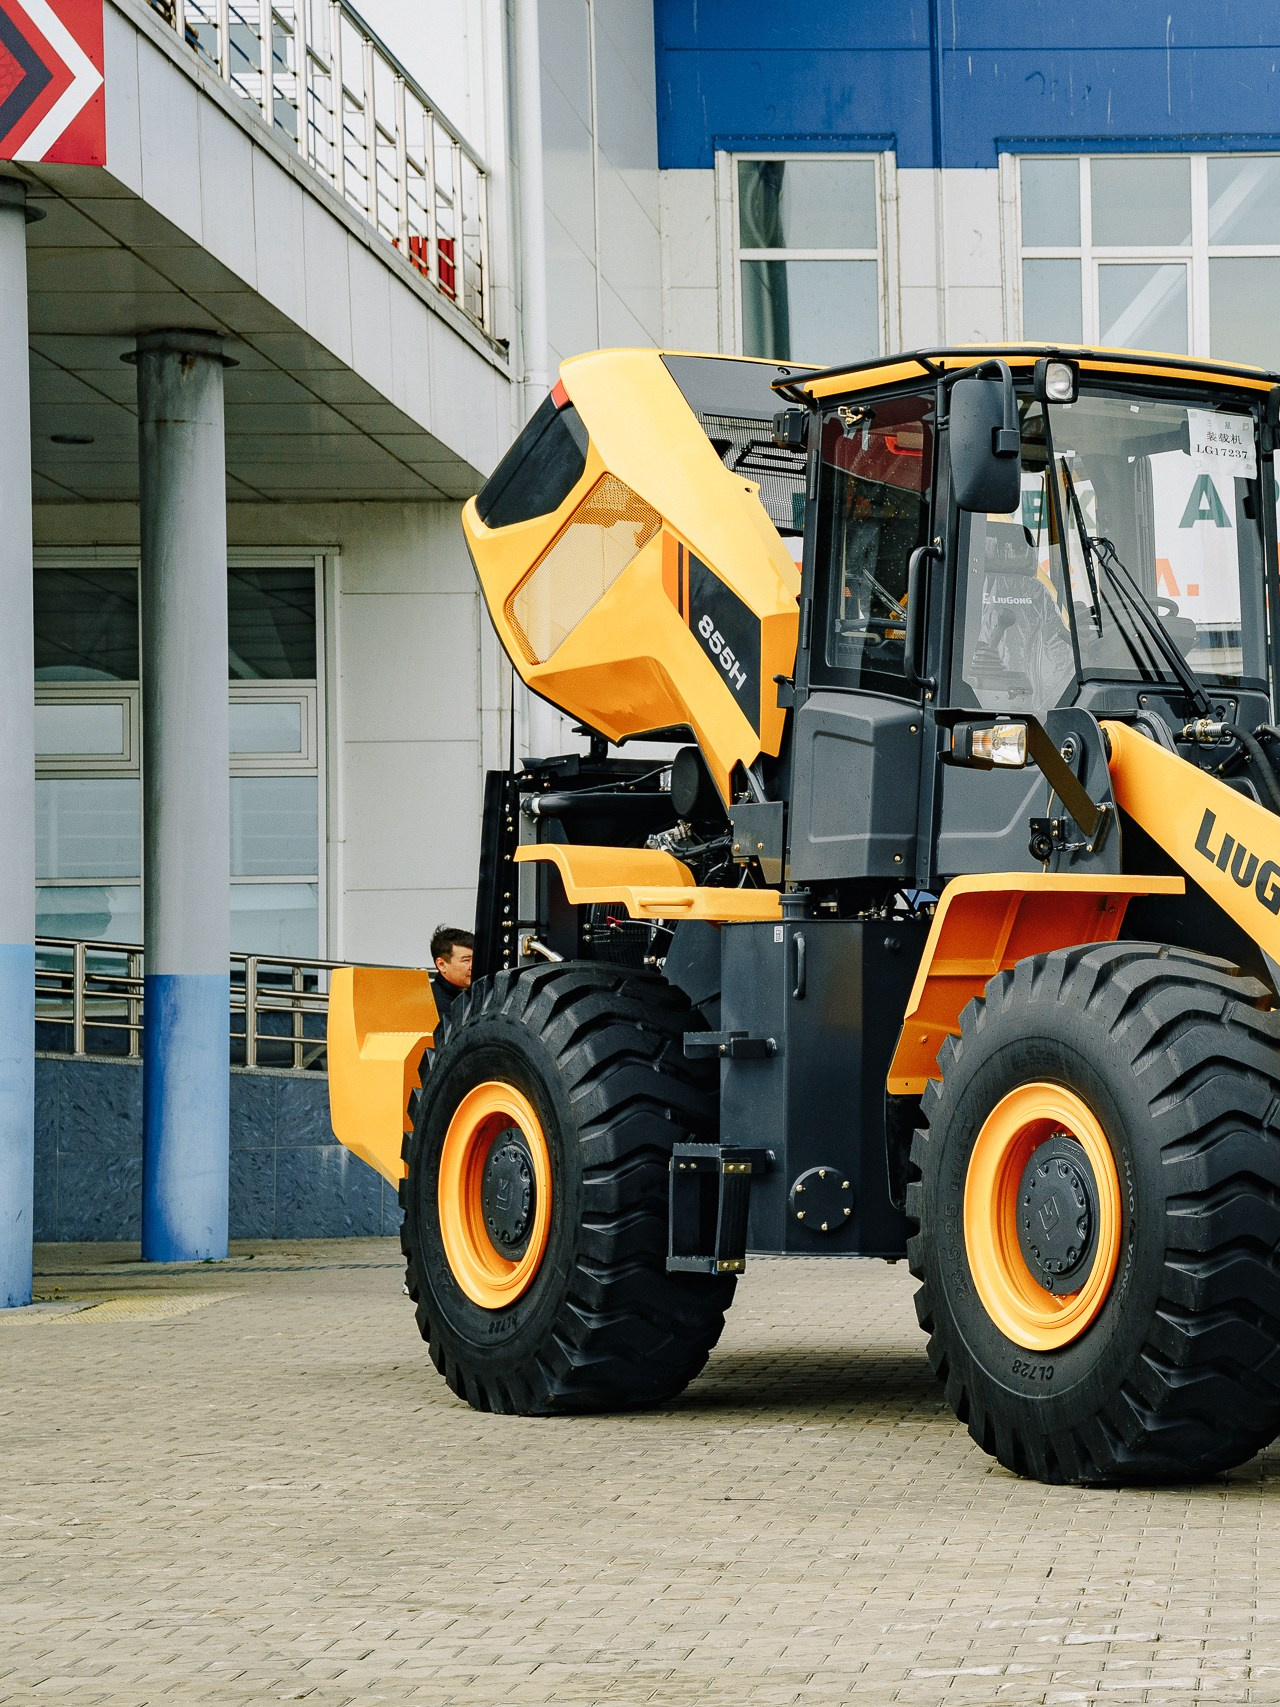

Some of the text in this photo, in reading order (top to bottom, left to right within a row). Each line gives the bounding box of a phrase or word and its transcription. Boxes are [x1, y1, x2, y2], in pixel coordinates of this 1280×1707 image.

[1196, 444, 1248, 459] LG17237
[698, 614, 748, 691] 855H
[944, 1202, 972, 1300] 23.5-25
[1012, 1358, 1055, 1380] CL728
